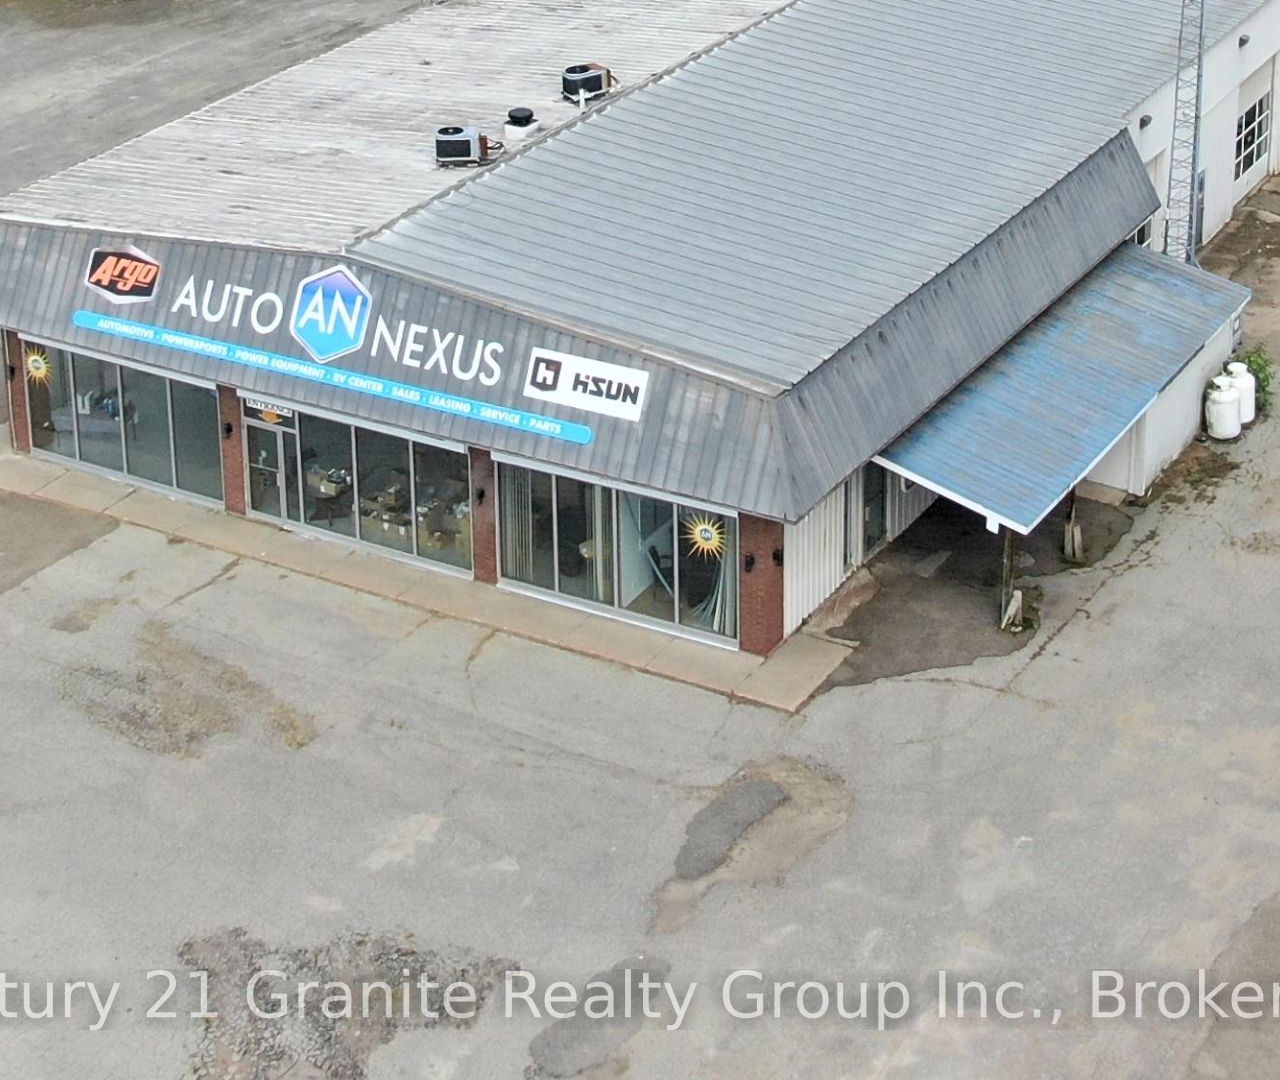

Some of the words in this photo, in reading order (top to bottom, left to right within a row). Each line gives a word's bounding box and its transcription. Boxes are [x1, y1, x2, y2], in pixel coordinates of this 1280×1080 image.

[89, 255, 158, 291] Argo
[97, 318, 155, 340] AUTOMOTIVE
[160, 333, 228, 356] POWERSPORTS
[234, 350, 269, 366] POWER
[271, 358, 326, 380] EQUIPMENT
[348, 375, 384, 394] CENTER
[391, 387, 420, 402] SALES
[429, 395, 471, 414] LEASING
[480, 407, 521, 426] SERVICE
[528, 418, 562, 435] PARTS
[171, 274, 284, 335] AUTO
[297, 285, 363, 340] AN
[370, 314, 505, 387] NEXUS
